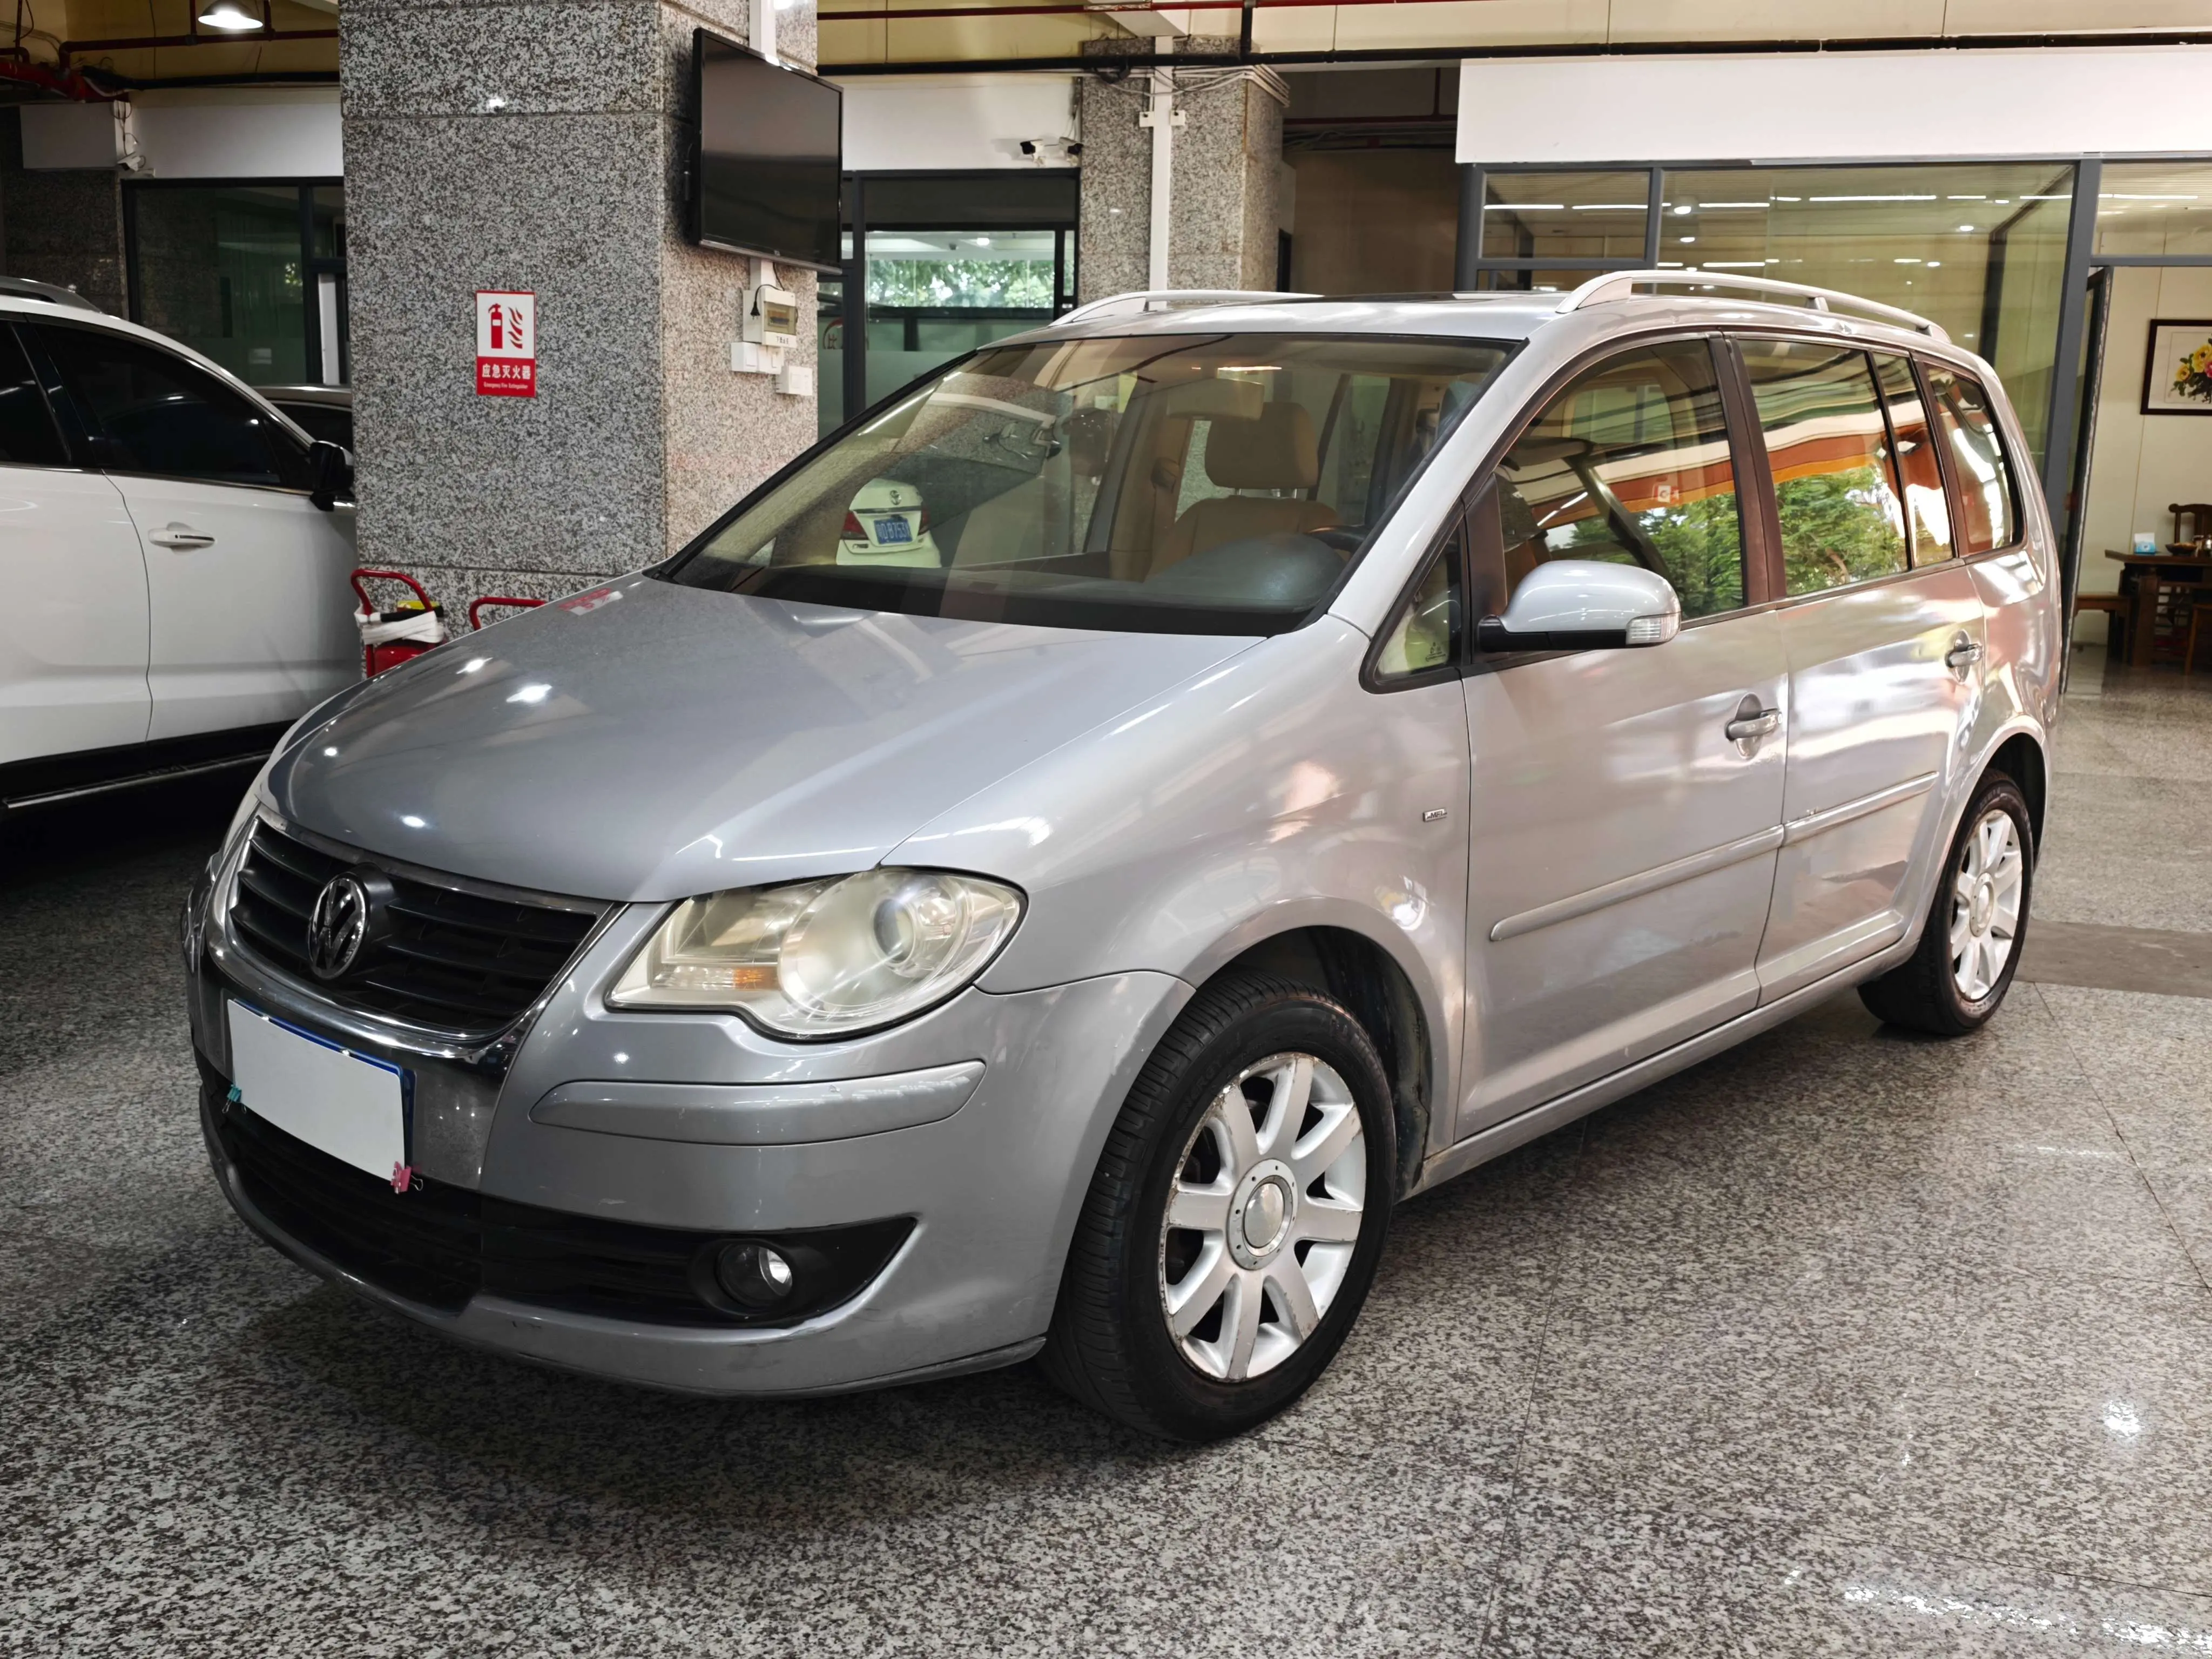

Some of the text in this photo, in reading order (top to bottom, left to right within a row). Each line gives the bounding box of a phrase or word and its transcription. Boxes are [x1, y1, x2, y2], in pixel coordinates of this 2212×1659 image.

[482, 363, 531, 380] 应急灭火器
